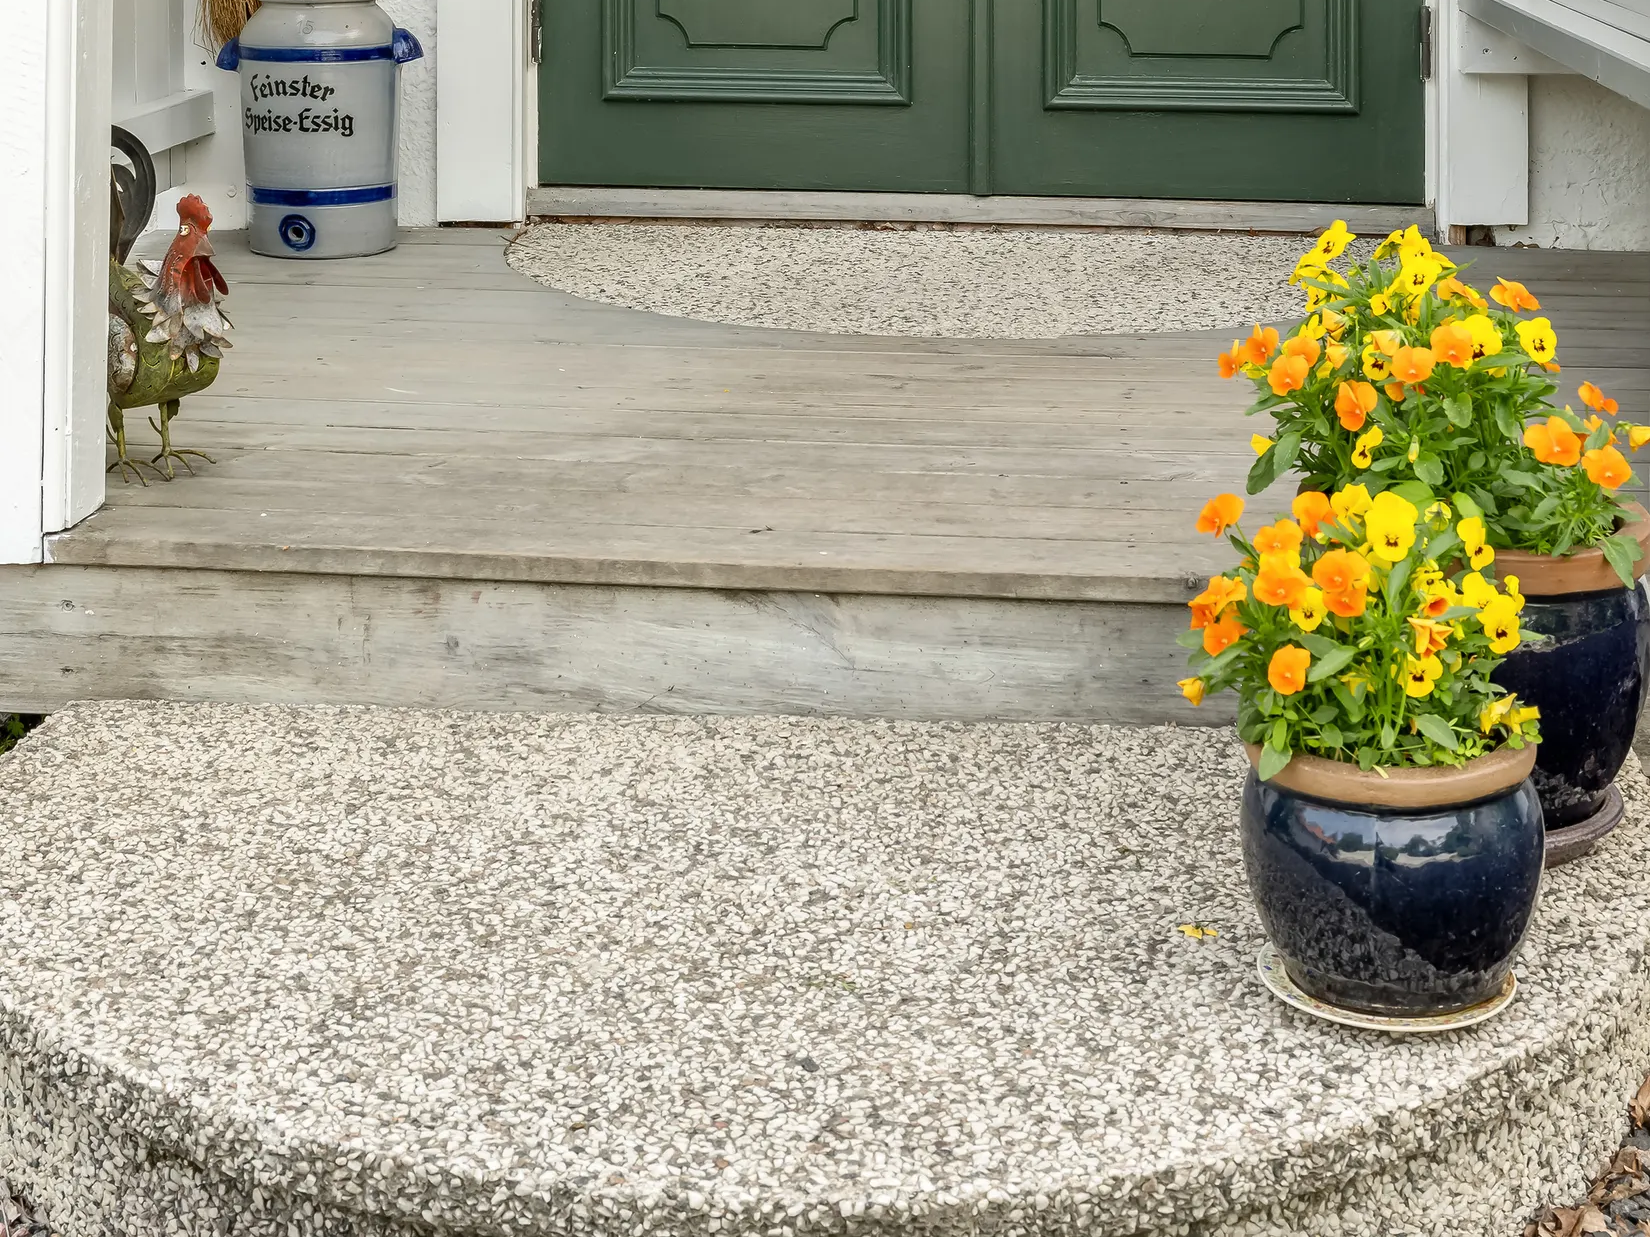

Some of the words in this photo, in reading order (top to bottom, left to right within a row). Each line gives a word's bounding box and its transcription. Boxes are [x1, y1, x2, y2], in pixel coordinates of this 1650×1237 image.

[296, 20, 314, 35] 15
[250, 73, 335, 102] Feinster
[245, 107, 354, 137] Speise-Essig
